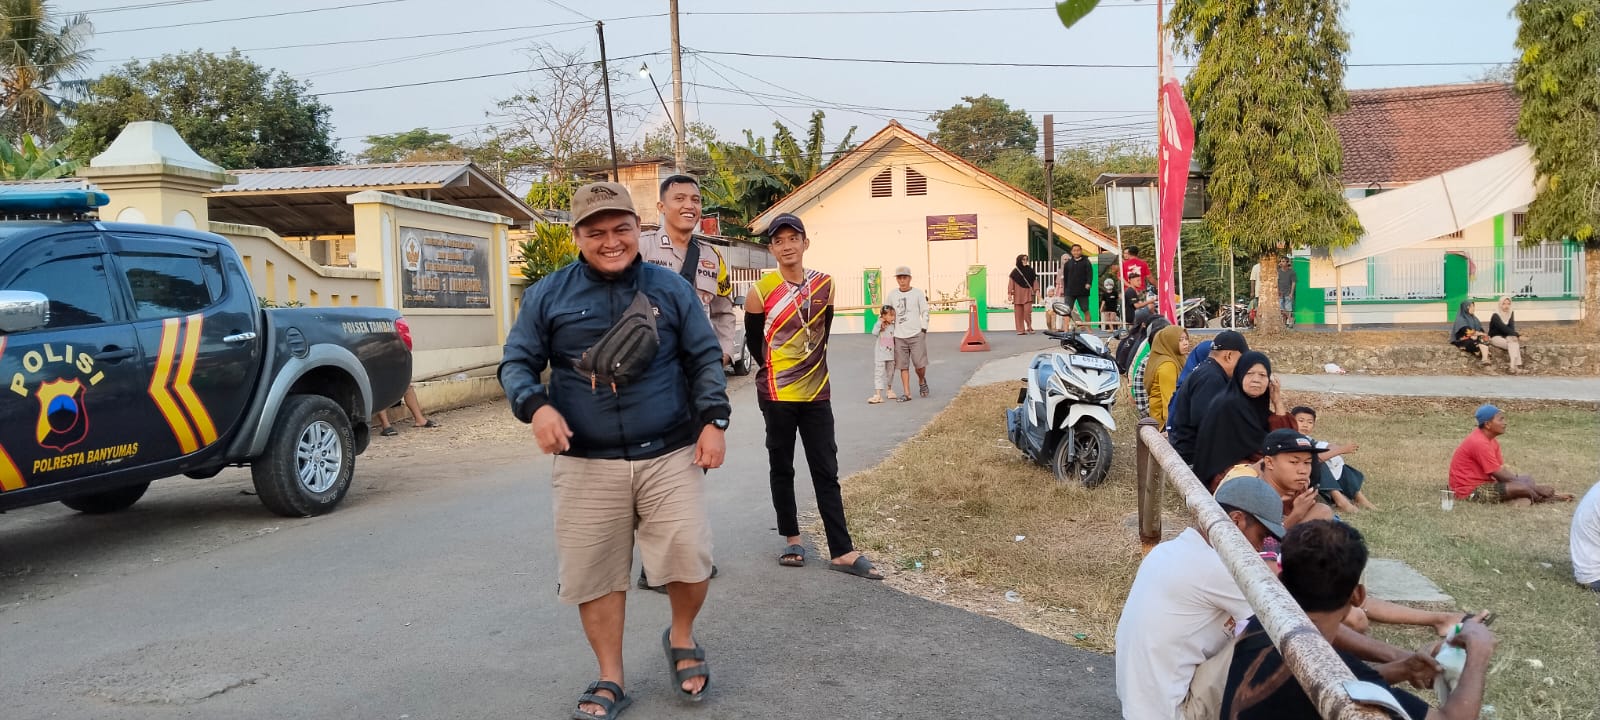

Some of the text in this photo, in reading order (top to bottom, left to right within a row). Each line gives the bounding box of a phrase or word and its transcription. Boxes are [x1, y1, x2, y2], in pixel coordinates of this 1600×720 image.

[342, 321, 369, 334] POLSEK
[10, 343, 105, 397] POLISI
[32, 442, 139, 474] POLRESTA BANYUMAS
